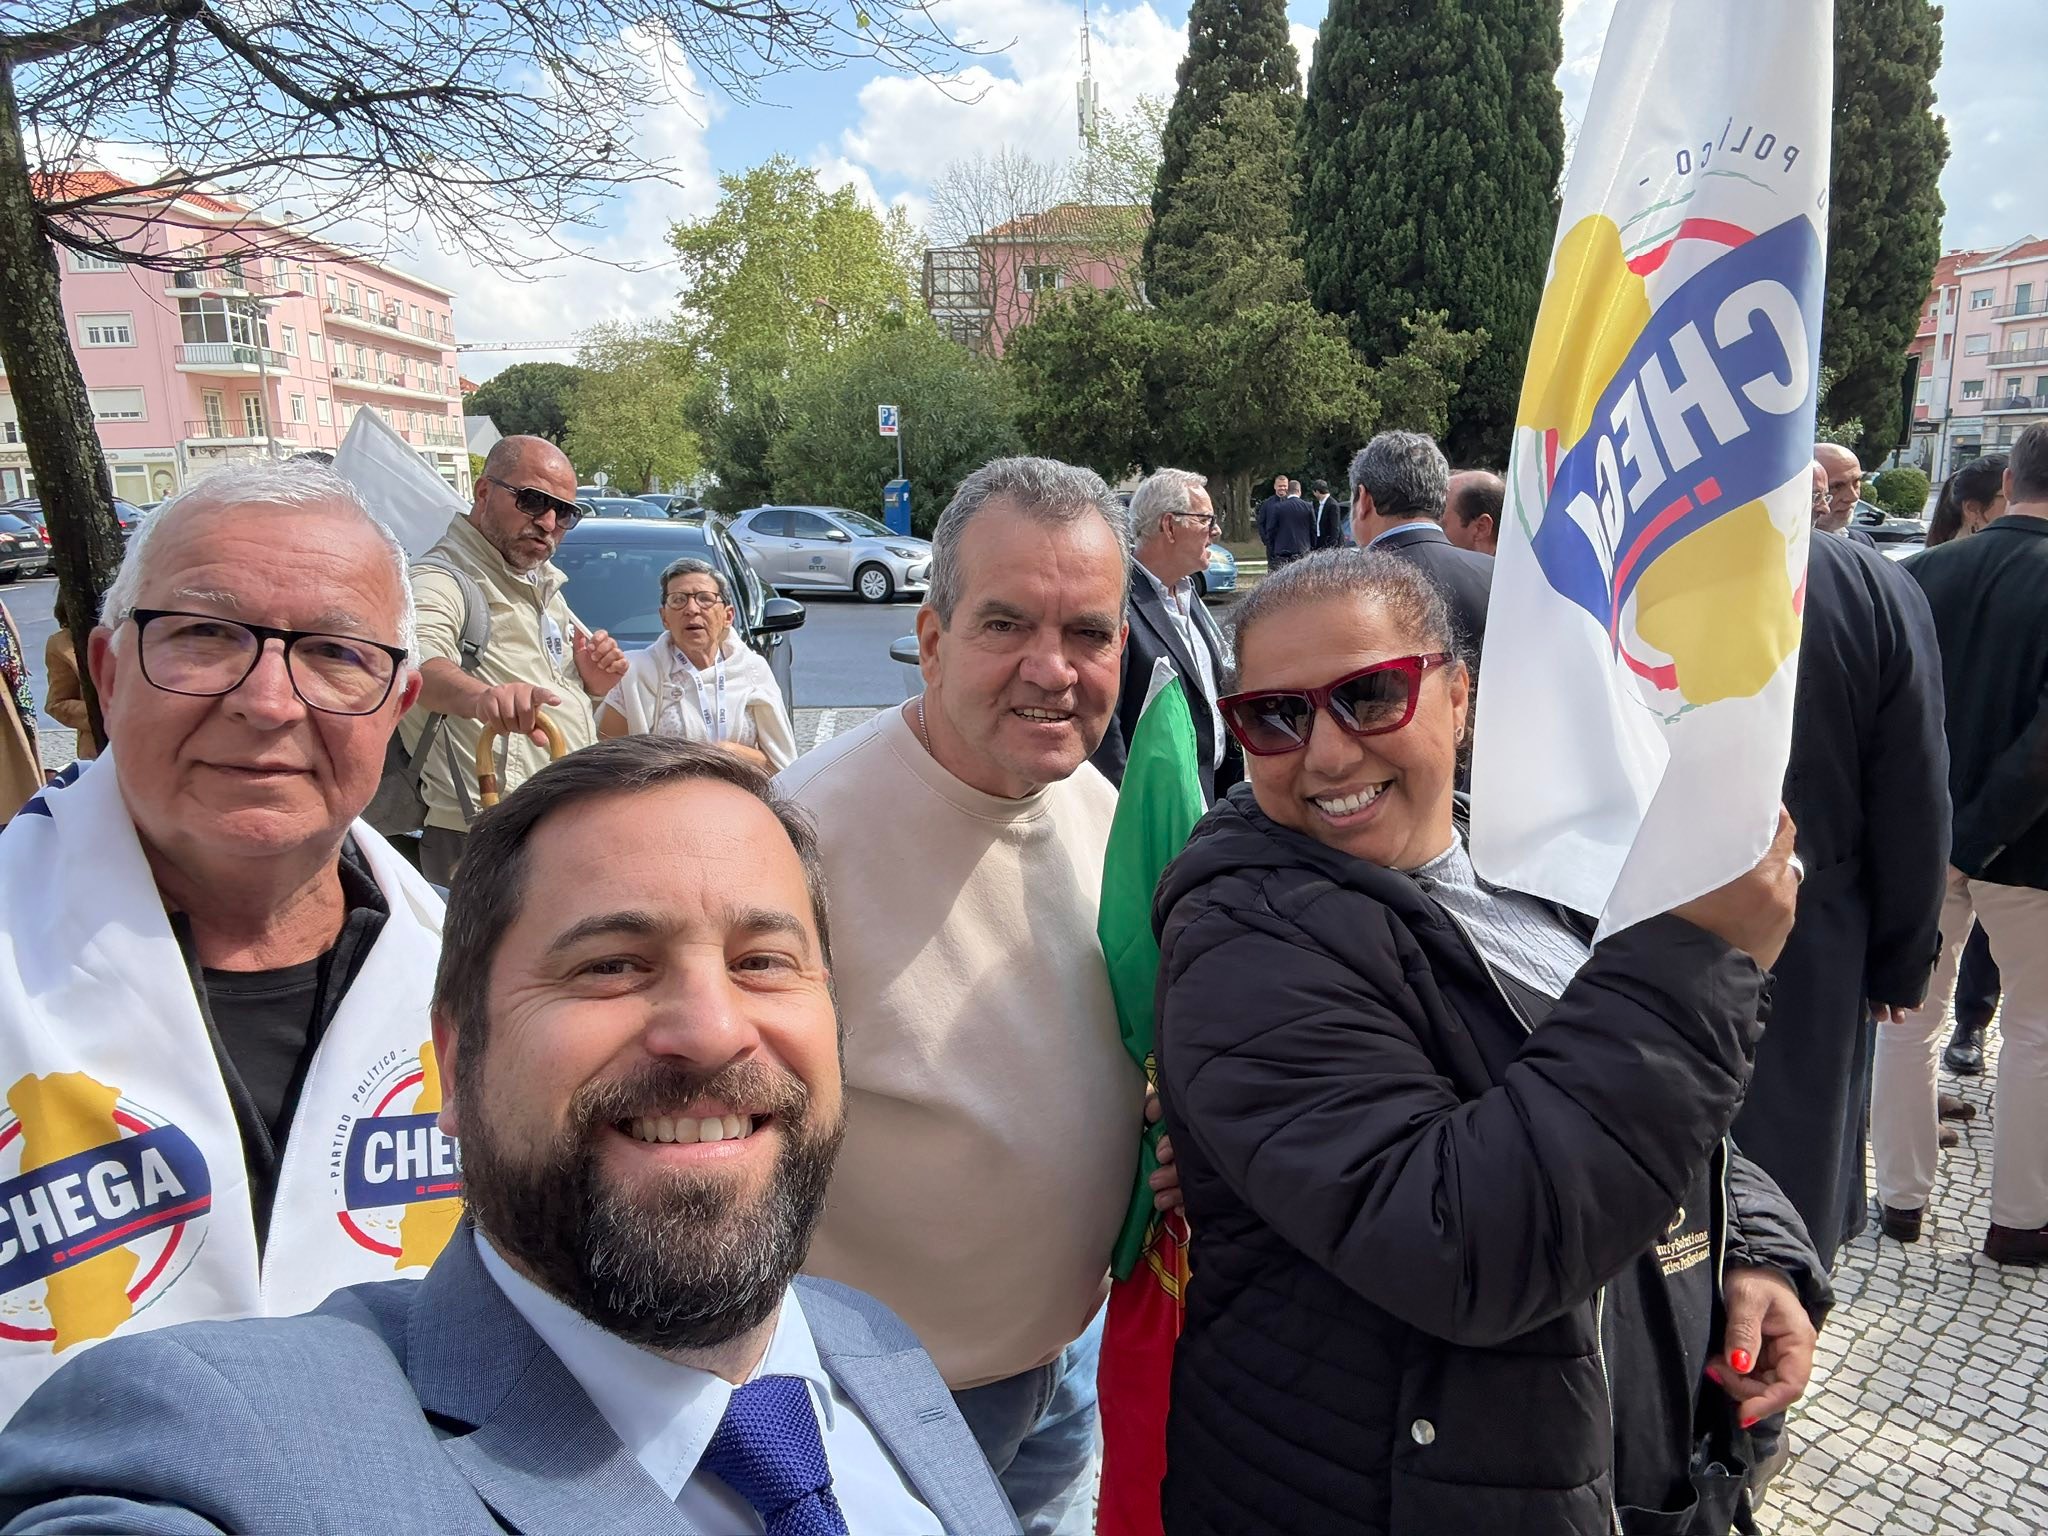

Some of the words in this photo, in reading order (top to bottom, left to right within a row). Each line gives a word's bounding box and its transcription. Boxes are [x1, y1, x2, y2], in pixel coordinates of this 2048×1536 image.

[882, 408, 889, 423] P
[330, 1114, 351, 1178] PARTIDO
[351, 1050, 396, 1103] POLÍTICO
[363, 1127, 464, 1184] CHE
